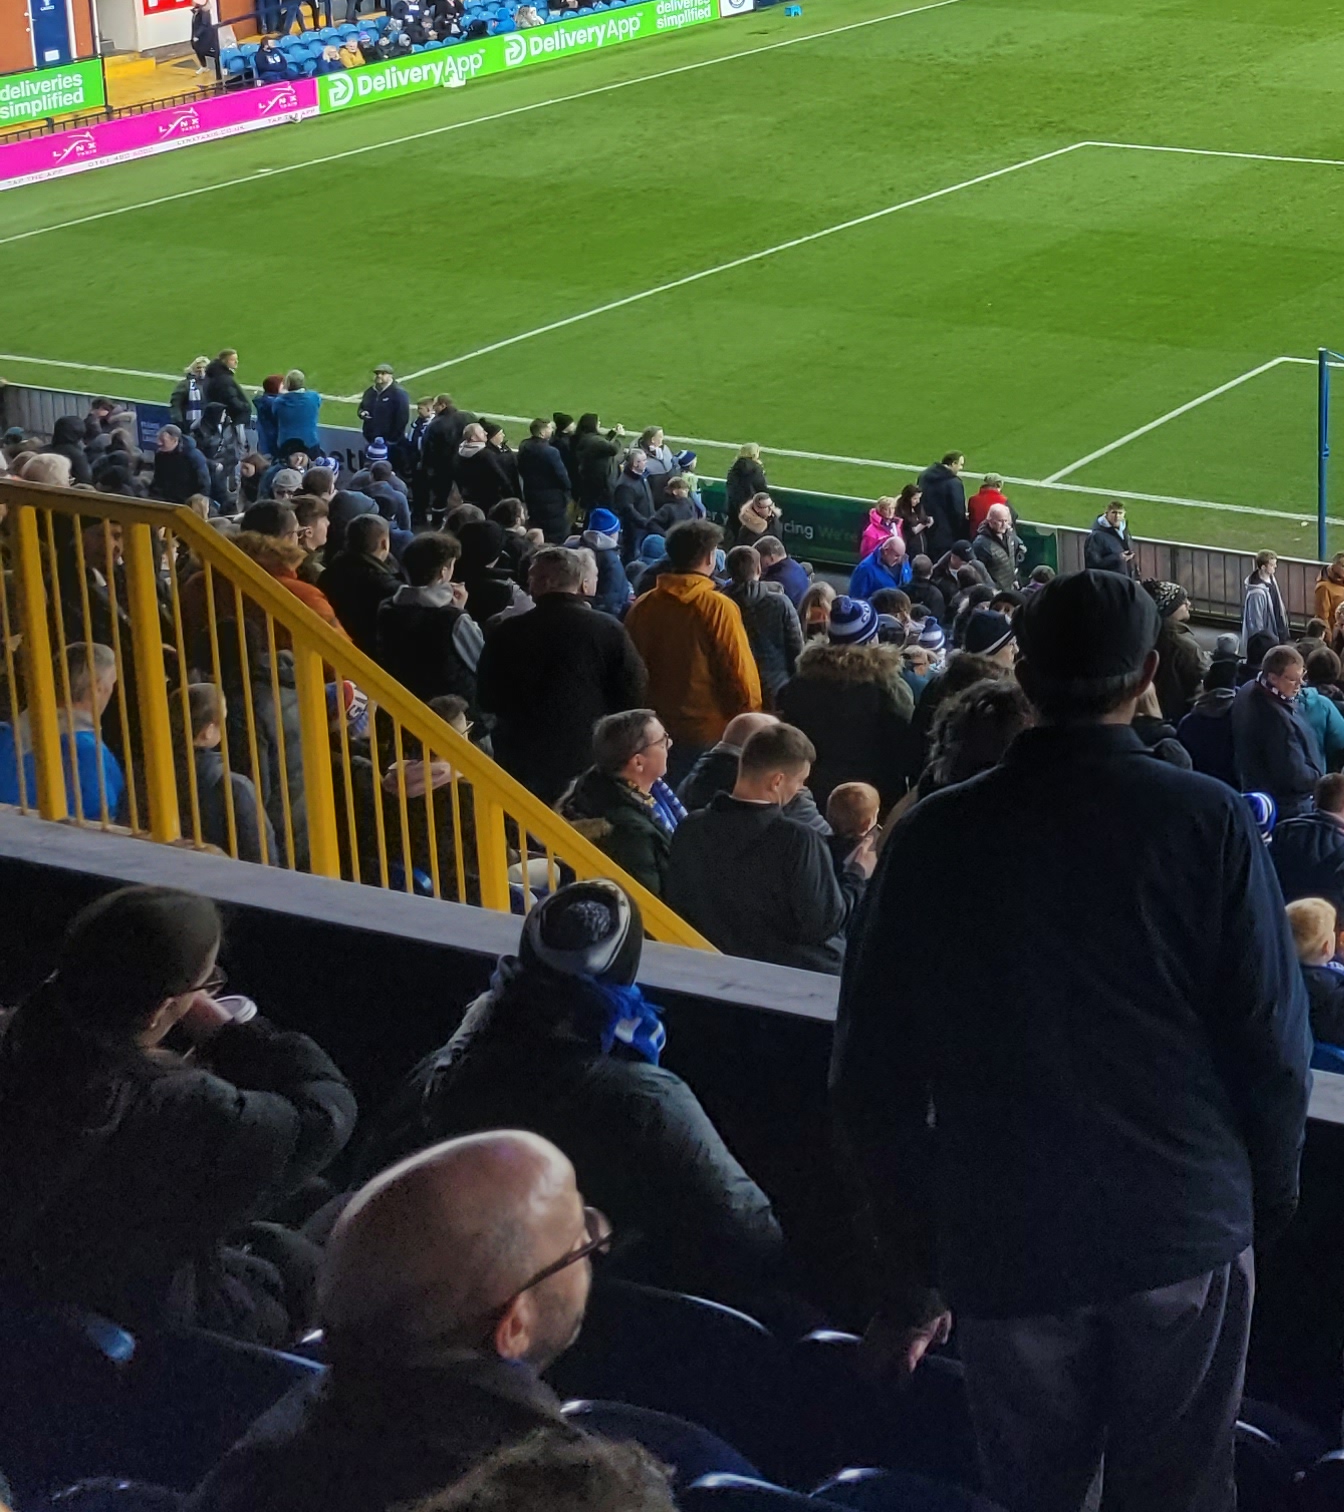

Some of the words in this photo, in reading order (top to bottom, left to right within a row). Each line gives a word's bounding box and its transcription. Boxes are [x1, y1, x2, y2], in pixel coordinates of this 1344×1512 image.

[656, 4, 712, 29] simplified
[529, 14, 640, 56] DeliveryApp
[0, 72, 83, 101] deliveries
[358, 52, 483, 95] DeliveryApp
[0, 88, 85, 120] simplified
